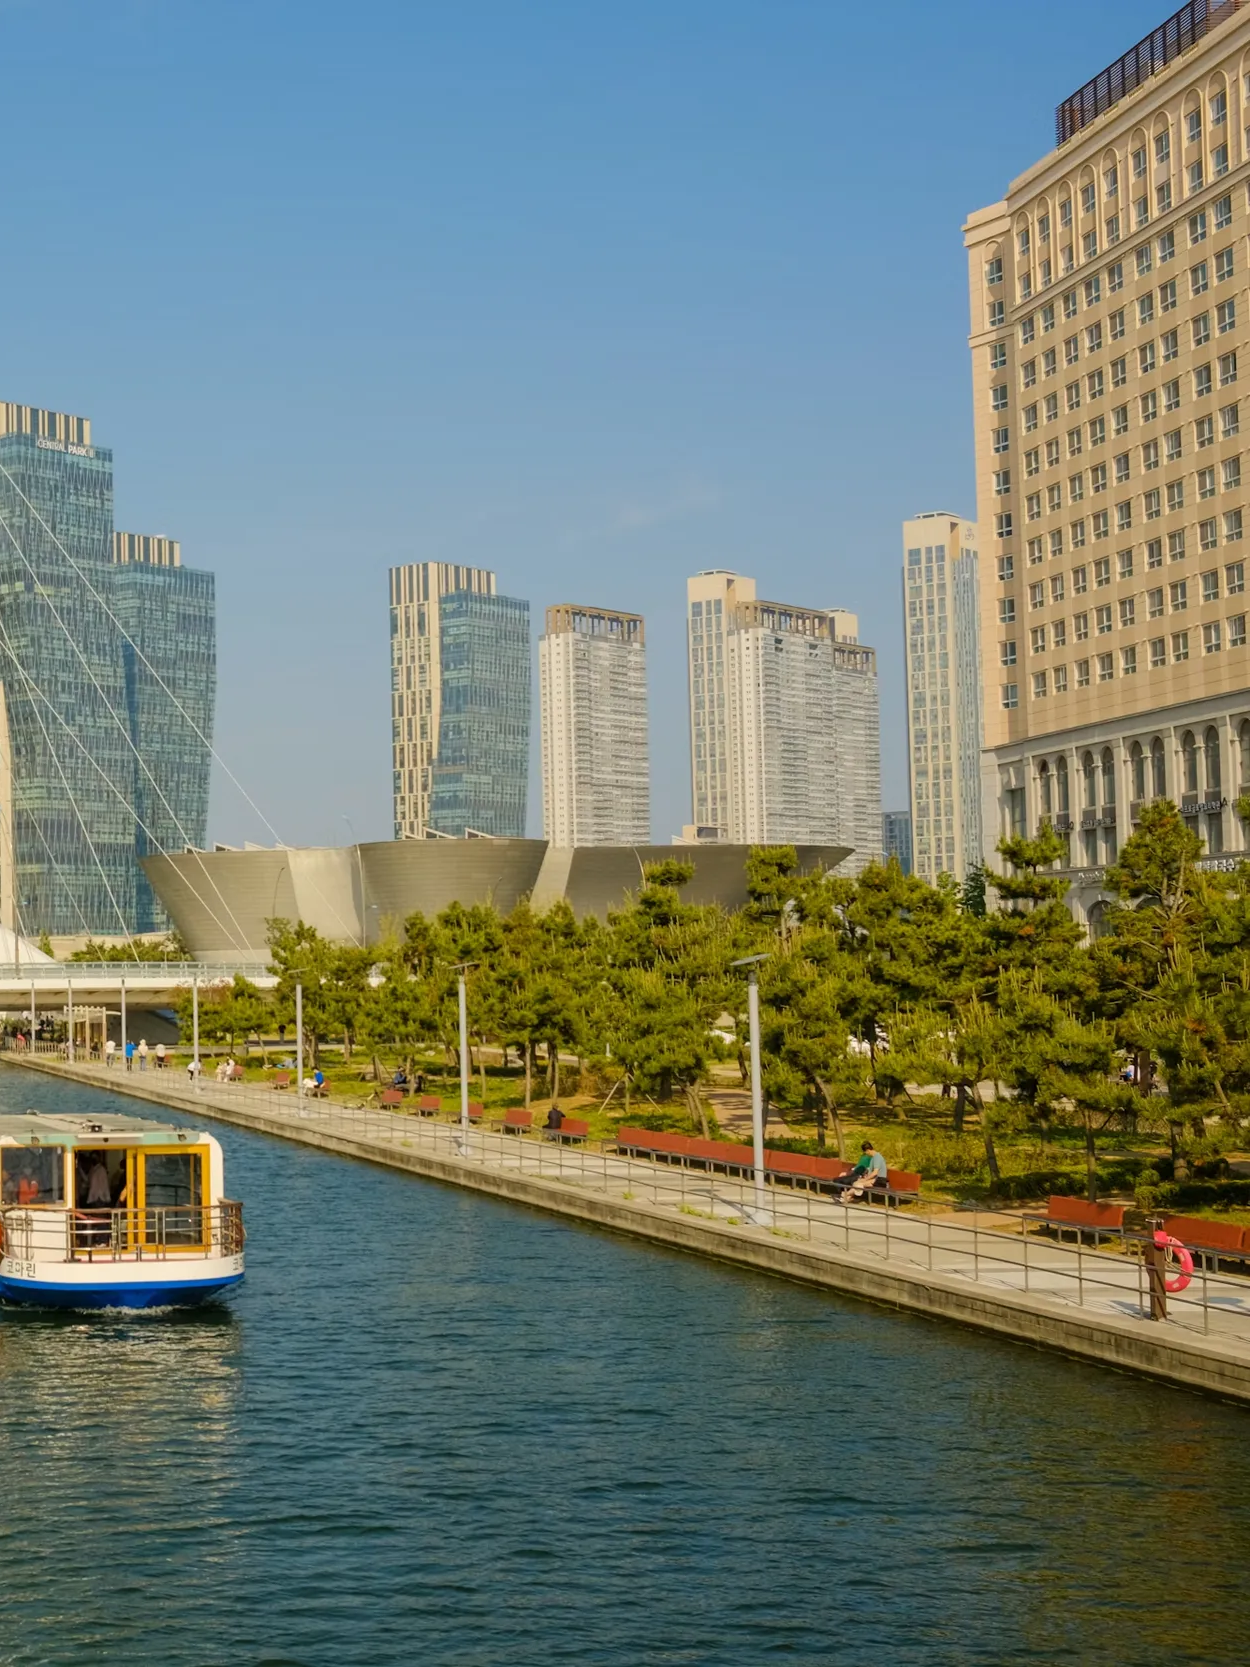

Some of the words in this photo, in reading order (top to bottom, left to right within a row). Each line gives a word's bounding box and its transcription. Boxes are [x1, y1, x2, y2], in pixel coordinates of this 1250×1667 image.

[37, 439, 67, 453] CENTRAL
[68, 444, 88, 457] PARK
[6, 1260, 36, 1278] 코마린
